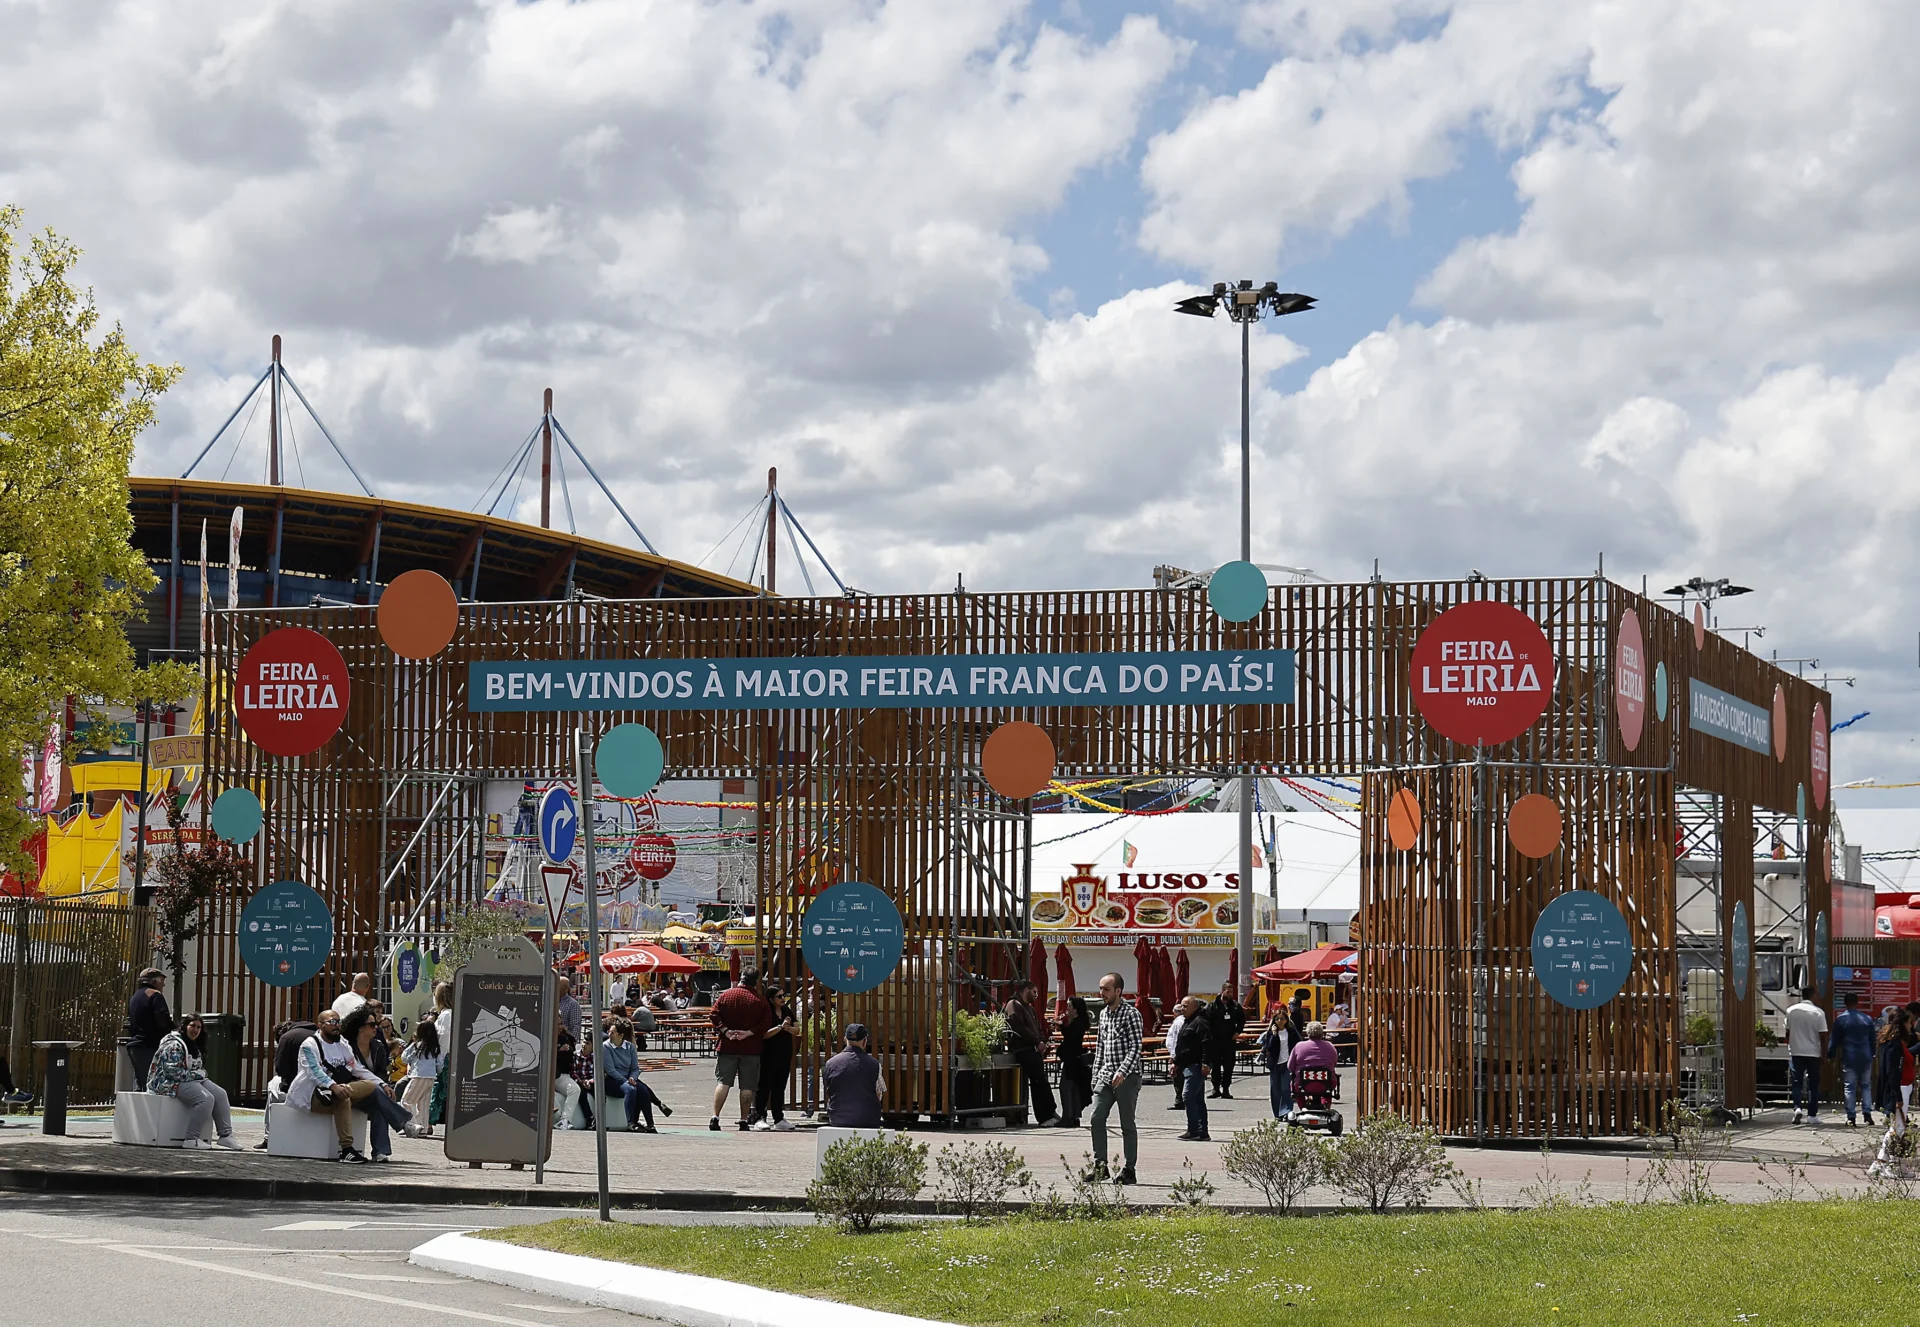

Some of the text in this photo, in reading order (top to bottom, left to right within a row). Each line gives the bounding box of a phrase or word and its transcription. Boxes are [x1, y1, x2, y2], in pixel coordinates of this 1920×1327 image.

[1441, 640, 1515, 661] FEIRA
[1623, 644, 1638, 669] FEIRA
[259, 662, 318, 681] FEIRA
[486, 655, 1274, 700] BEM-VINDOS À MAIOR FEIRA FRANCA DO PAÍS!
[1422, 663, 1541, 693] LEIRIA
[1618, 667, 1643, 703] LEIRIA
[243, 684, 339, 709] LEIRIA
[1466, 696, 1497, 706] MAIO
[1693, 691, 1699, 719] A
[278, 712, 303, 721] MAIO
[152, 831, 176, 841] SERR
[182, 831, 194, 840] DA
[634, 851, 673, 863] LEIRIA
[1056, 935, 1069, 944] BOX
[1072, 935, 1109, 944] CACHORROS
[1113, 935, 1156, 944] HAMBURER
[1160, 935, 1184, 944] DURUM
[1187, 935, 1213, 945] BATATA
[1213, 935, 1232, 945] FRITA
[1252, 936, 1269, 946] EBAB
[603, 952, 648, 965] SUPER
[506, 982, 515, 991] de
